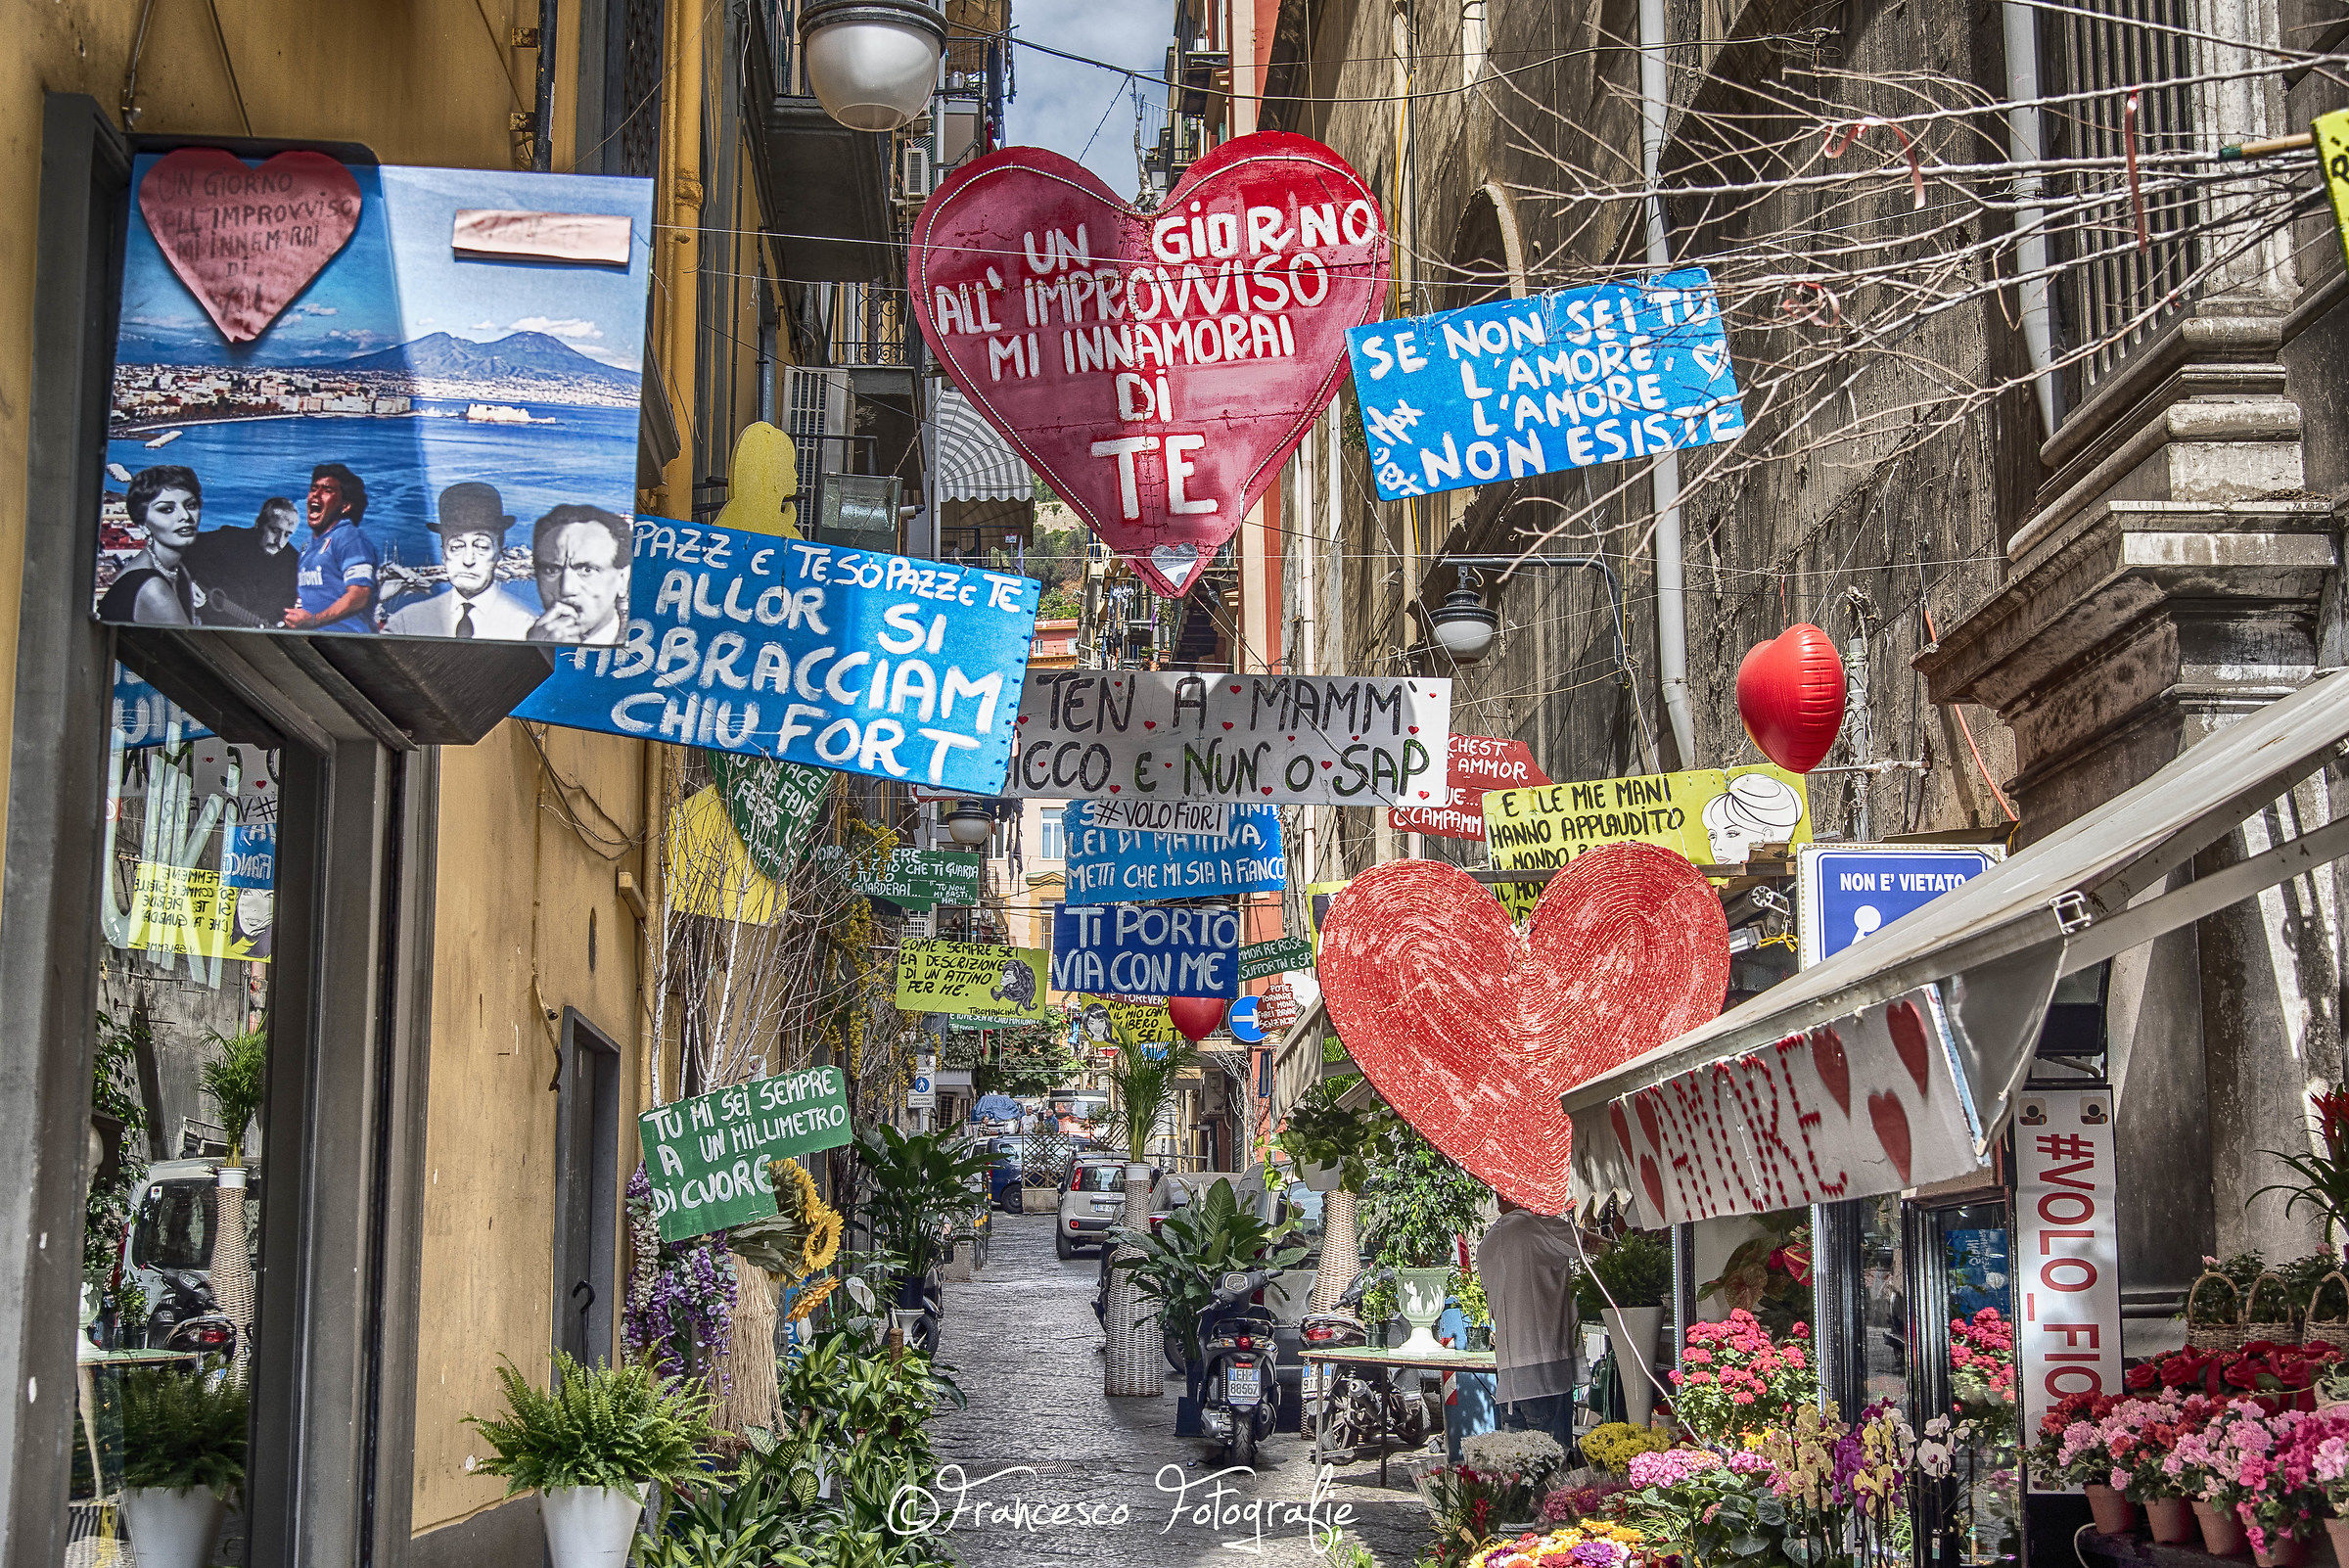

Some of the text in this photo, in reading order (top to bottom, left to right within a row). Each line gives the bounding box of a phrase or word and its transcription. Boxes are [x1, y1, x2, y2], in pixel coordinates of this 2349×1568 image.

[1024, 222, 1089, 275] UN
[935, 252, 1329, 337] ALL' IMPROVVISO
[989, 313, 1296, 383] MI INNAMORAI
[1360, 331, 1428, 382] SE
[1442, 311, 1546, 360] NON
[1652, 288, 1712, 328] TU
[1472, 373, 1668, 438] L'AMORE
[1419, 394, 1745, 488] NON ESISTE
[1090, 434, 1219, 521] TE
[655, 568, 831, 635] ALLOR
[982, 573, 1024, 614] TE
[877, 602, 947, 655] SI
[1035, 670, 1135, 734] TEN
[1172, 676, 1210, 729] A
[611, 691, 982, 784] CHIU FORT
[1183, 737, 1272, 797] NUN
[1284, 754, 1316, 793] O
[1332, 739, 1430, 797] SAP
[1457, 758, 1529, 780] AMMOR
[1501, 791, 1520, 818] E
[1538, 786, 1564, 814] LE
[1068, 829, 1107, 857] LEI
[1489, 819, 1552, 850] HANNO
[904, 862, 929, 876] CHE
[944, 861, 979, 880] GUARDA
[1123, 862, 1158, 889] CHE
[1163, 861, 1181, 887] MI
[1185, 860, 1216, 886] SIA
[1221, 861, 1233, 885] A
[1839, 873, 1966, 892] NON E' VIETATO
[900, 939, 939, 953] COME
[946, 941, 992, 956] SEMPRE
[1116, 905, 1240, 950] PORTO
[899, 952, 1005, 972] LA DESCRIZIONE
[924, 968, 942, 981] UN
[1053, 948, 1226, 992] VIA CON ME
[906, 980, 935, 993] PER
[1125, 1009, 1144, 1020] MIO
[642, 1108, 684, 1142] TU
[760, 1069, 838, 1111] SEMPRE
[657, 1143, 685, 1178] A
[698, 1129, 726, 1163] UN
[681, 1154, 774, 1210] CUORE
[1230, 1382, 1259, 1394] 88567
